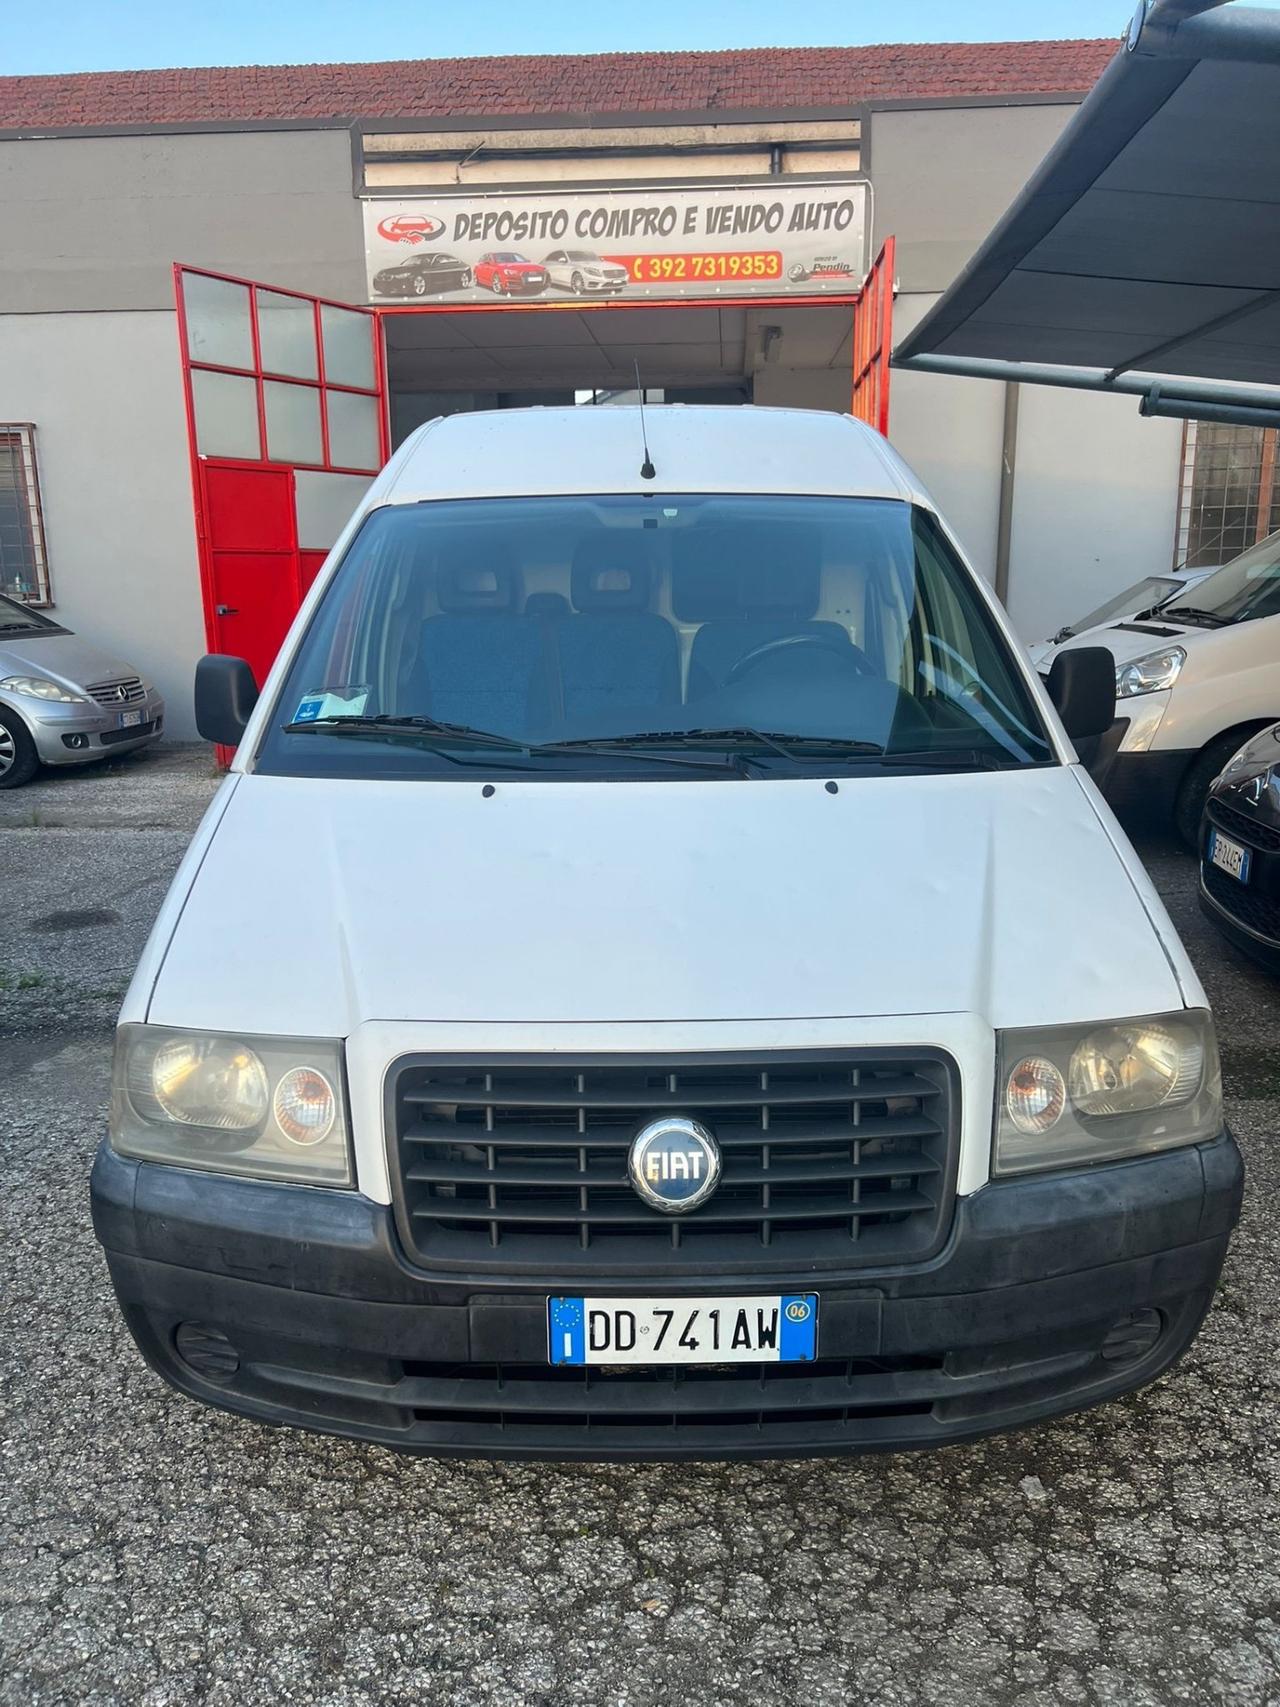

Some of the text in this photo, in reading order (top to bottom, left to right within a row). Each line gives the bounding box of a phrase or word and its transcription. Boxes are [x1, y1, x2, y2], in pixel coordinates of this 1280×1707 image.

[453, 199, 855, 242] DEPOSITO COMPRO E VENDO AUTO
[648, 255, 779, 280] 392 7319353
[646, 1151, 704, 1180] FIAT
[790, 1305, 806, 1317] 06
[589, 1310, 636, 1351] DD
